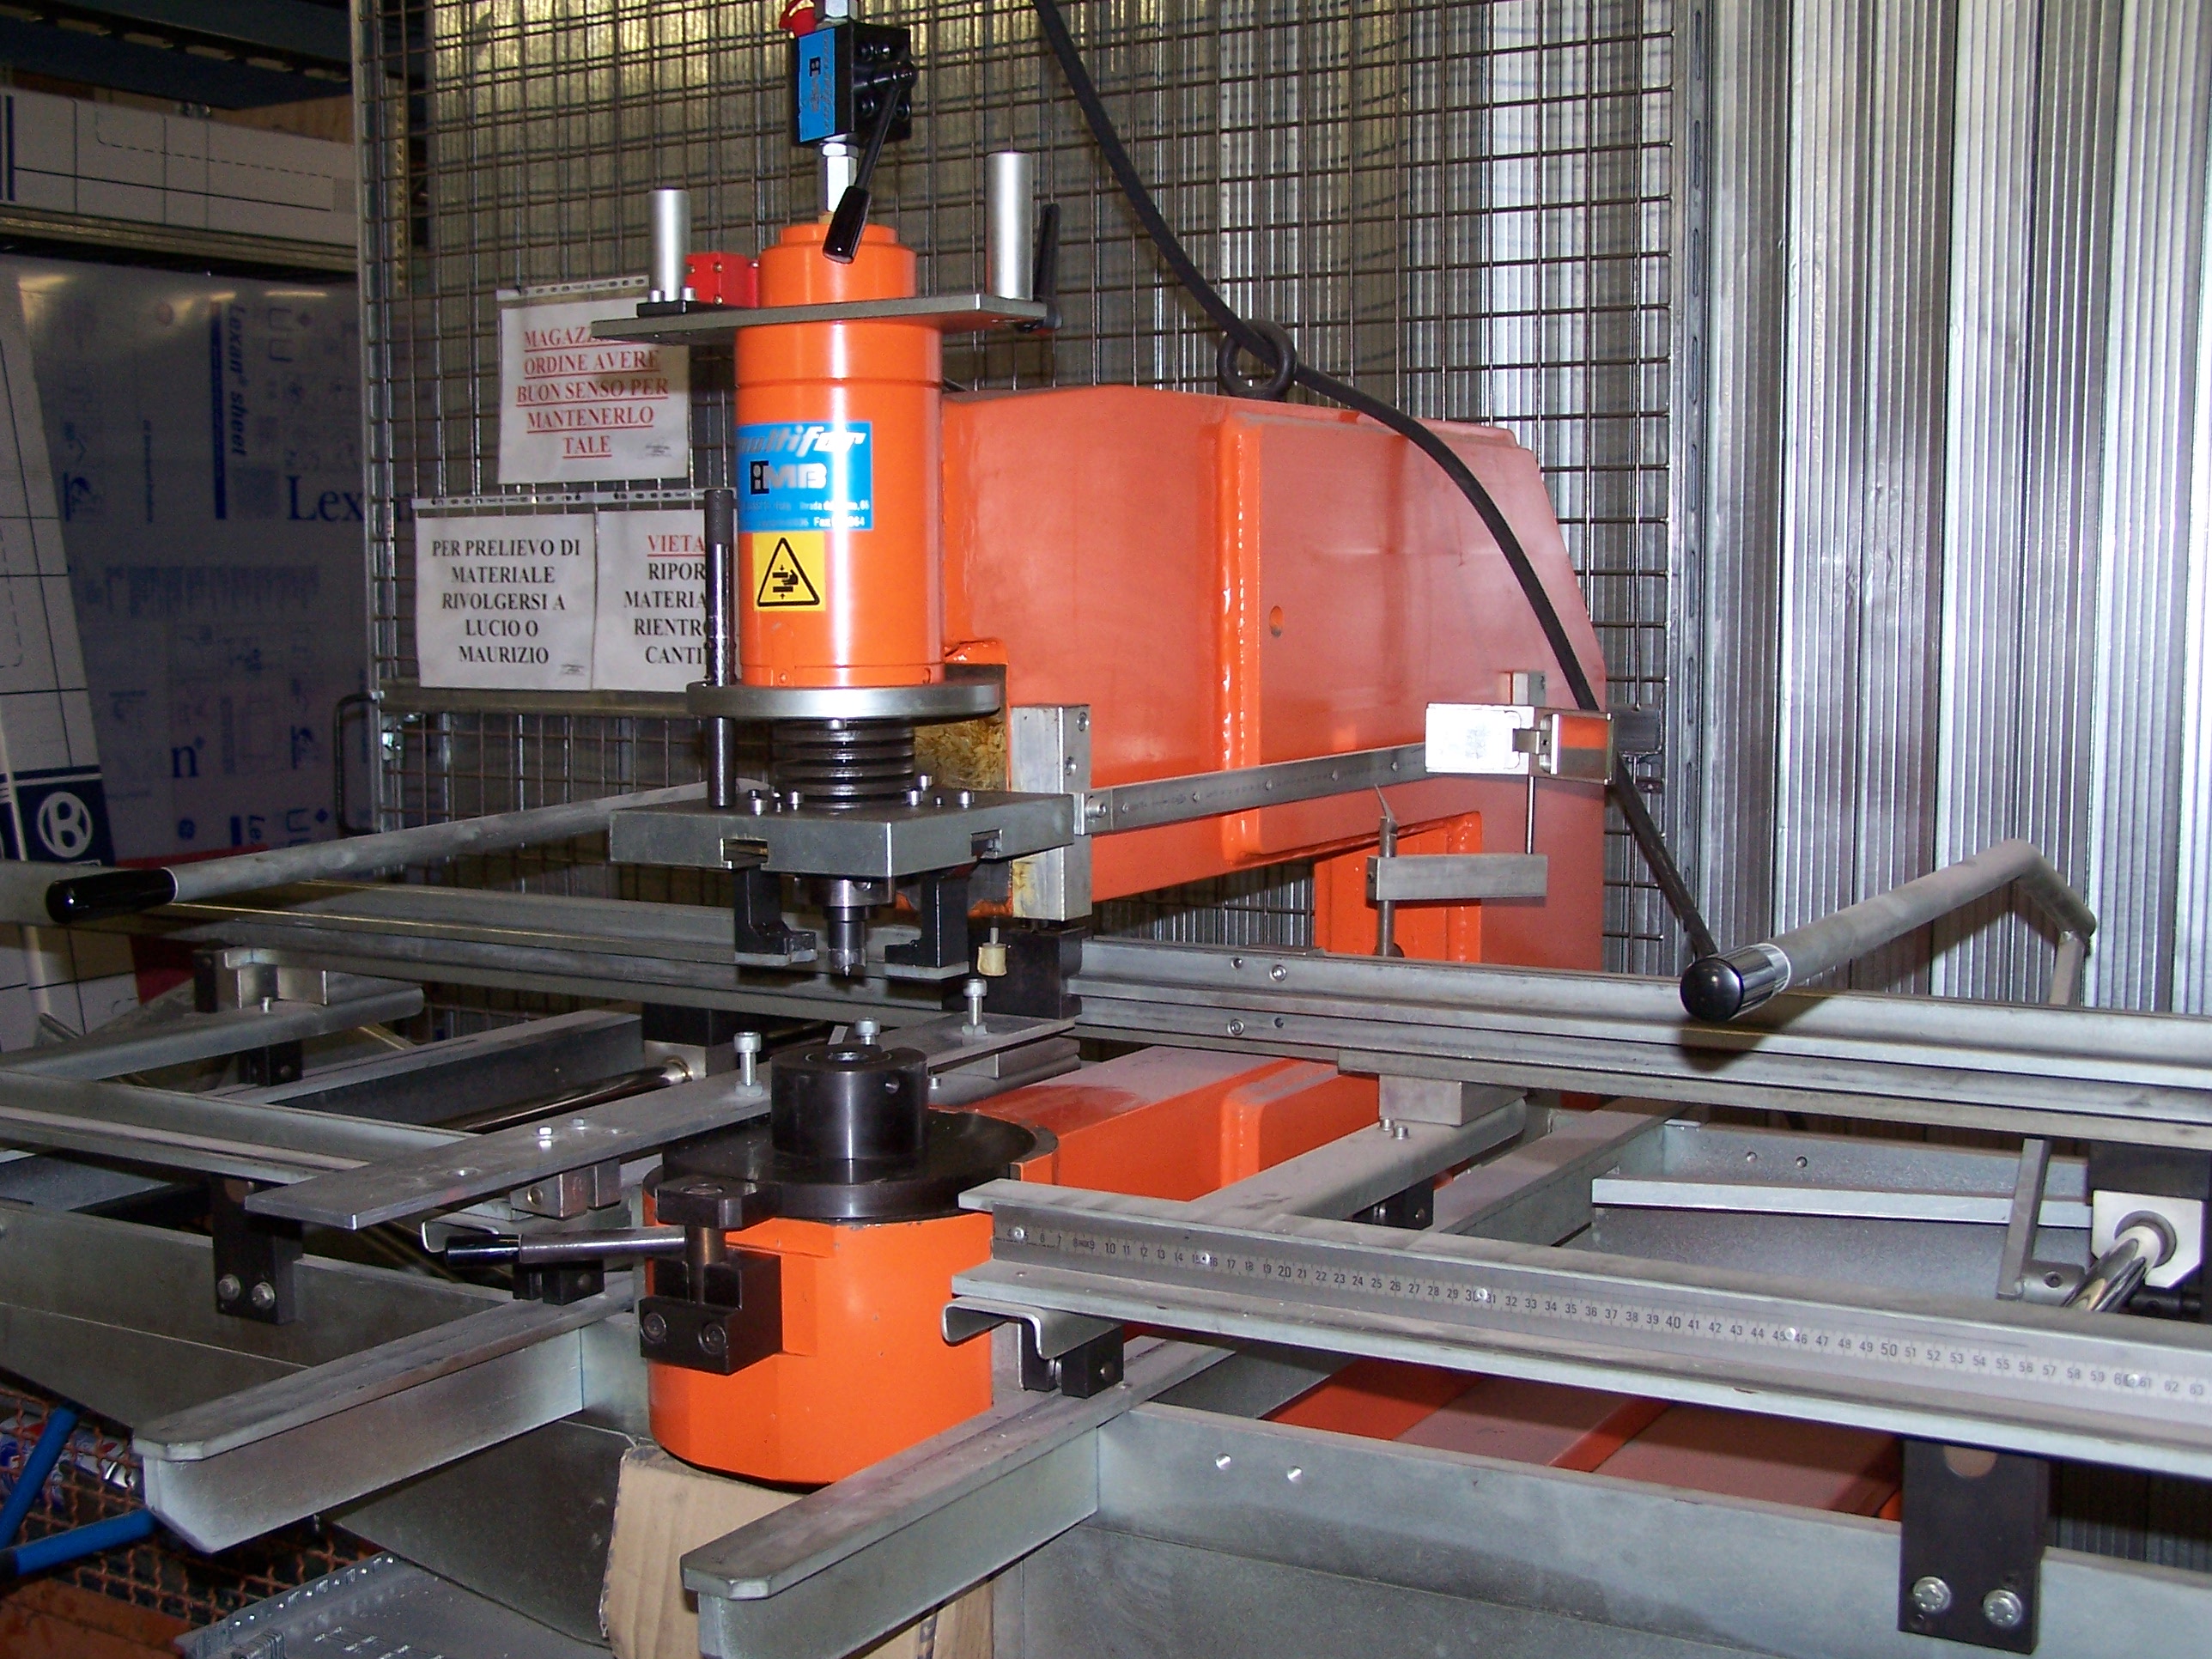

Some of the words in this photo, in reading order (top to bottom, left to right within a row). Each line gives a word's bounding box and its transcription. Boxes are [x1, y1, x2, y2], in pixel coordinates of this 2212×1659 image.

[524, 326, 592, 347] MAGAZ
[525, 353, 588, 375] ORDINE
[593, 349, 660, 370] AVERE
[518, 382, 561, 403] BUON
[565, 380, 623, 399] SENSO
[629, 378, 670, 396] PER
[231, 391, 247, 455] sheet
[527, 405, 654, 428] MANTENERLO
[562, 435, 611, 454] TALE
[287, 475, 413, 521] Lexn
[432, 539, 460, 556] PER
[465, 539, 554, 556] PRELIEVO
[560, 539, 580, 556] DI
[647, 534, 705, 552] VIETA
[452, 566, 556, 584] MATERIALE
[648, 562, 706, 580] RIPOR
[442, 592, 547, 611] RIVOLGERSI
[552, 594, 566, 611] A
[623, 591, 706, 609] MATERIA
[465, 619, 520, 637] LUCIO
[526, 620, 538, 637] O
[634, 618, 705, 636] RIENTR
[459, 646, 549, 664] MAURIZIO
[646, 646, 706, 665] CANTI
[1105, 1243, 1115, 1254] 10
[1123, 1245, 1130, 1255] 11
[1140, 1247, 1147, 1257] 12
[1158, 1249, 1165, 1259] 13
[1175, 1253, 1183, 1262] 14
[1227, 1259, 1236, 1268] 17
[1245, 1261, 1254, 1271] 18
[1263, 1263, 1271, 1273] 19
[1278, 1265, 1291, 1278] 20
[1297, 1268, 1306, 1278] 21
[1316, 1270, 1327, 1281] 22
[1334, 1273, 1345, 1283] 23
[1352, 1275, 1363, 1285] 24
[1370, 1278, 1382, 1288] 25
[1389, 1280, 1401, 1291] 26
[1408, 1283, 1420, 1294] 27
[1427, 1285, 1439, 1296] 28
[1447, 1288, 1458, 1298] 29
[1505, 1296, 1517, 1307] 32
[1525, 1299, 1537, 1310] 33
[1545, 1301, 1557, 1311] 34
[1565, 1304, 1577, 1314] 35
[1585, 1306, 1597, 1317] 36
[1605, 1309, 1617, 1320] 37
[1626, 1311, 1638, 1322] 38
[1646, 1314, 1659, 1325] 39
[1665, 1316, 1680, 1329] 40
[1687, 1320, 1699, 1330] 41
[1708, 1322, 1721, 1333] 42
[1729, 1325, 1743, 1336] 43
[1751, 1328, 1764, 1339] 44
[1815, 1335, 1828, 1346] 47
[1838, 1338, 1850, 1349] 48
[1859, 1340, 1873, 1352] 49
[1881, 1342, 1898, 1357] 50
[1905, 1346, 1917, 1358] 51
[1926, 1350, 1940, 1362] 52
[1949, 1352, 1964, 1364] 53
[1972, 1355, 1986, 1367] 54
[1996, 1358, 2009, 1370] 55
[2019, 1361, 2033, 1373] 56
[2042, 1364, 2057, 1376] 57
[2067, 1368, 2081, 1380] 58
[2090, 1370, 2105, 1382] 59
[2139, 1376, 2151, 1389] 61
[2164, 1380, 2179, 1393] 62
[2189, 1383, 2203, 1395] 63
